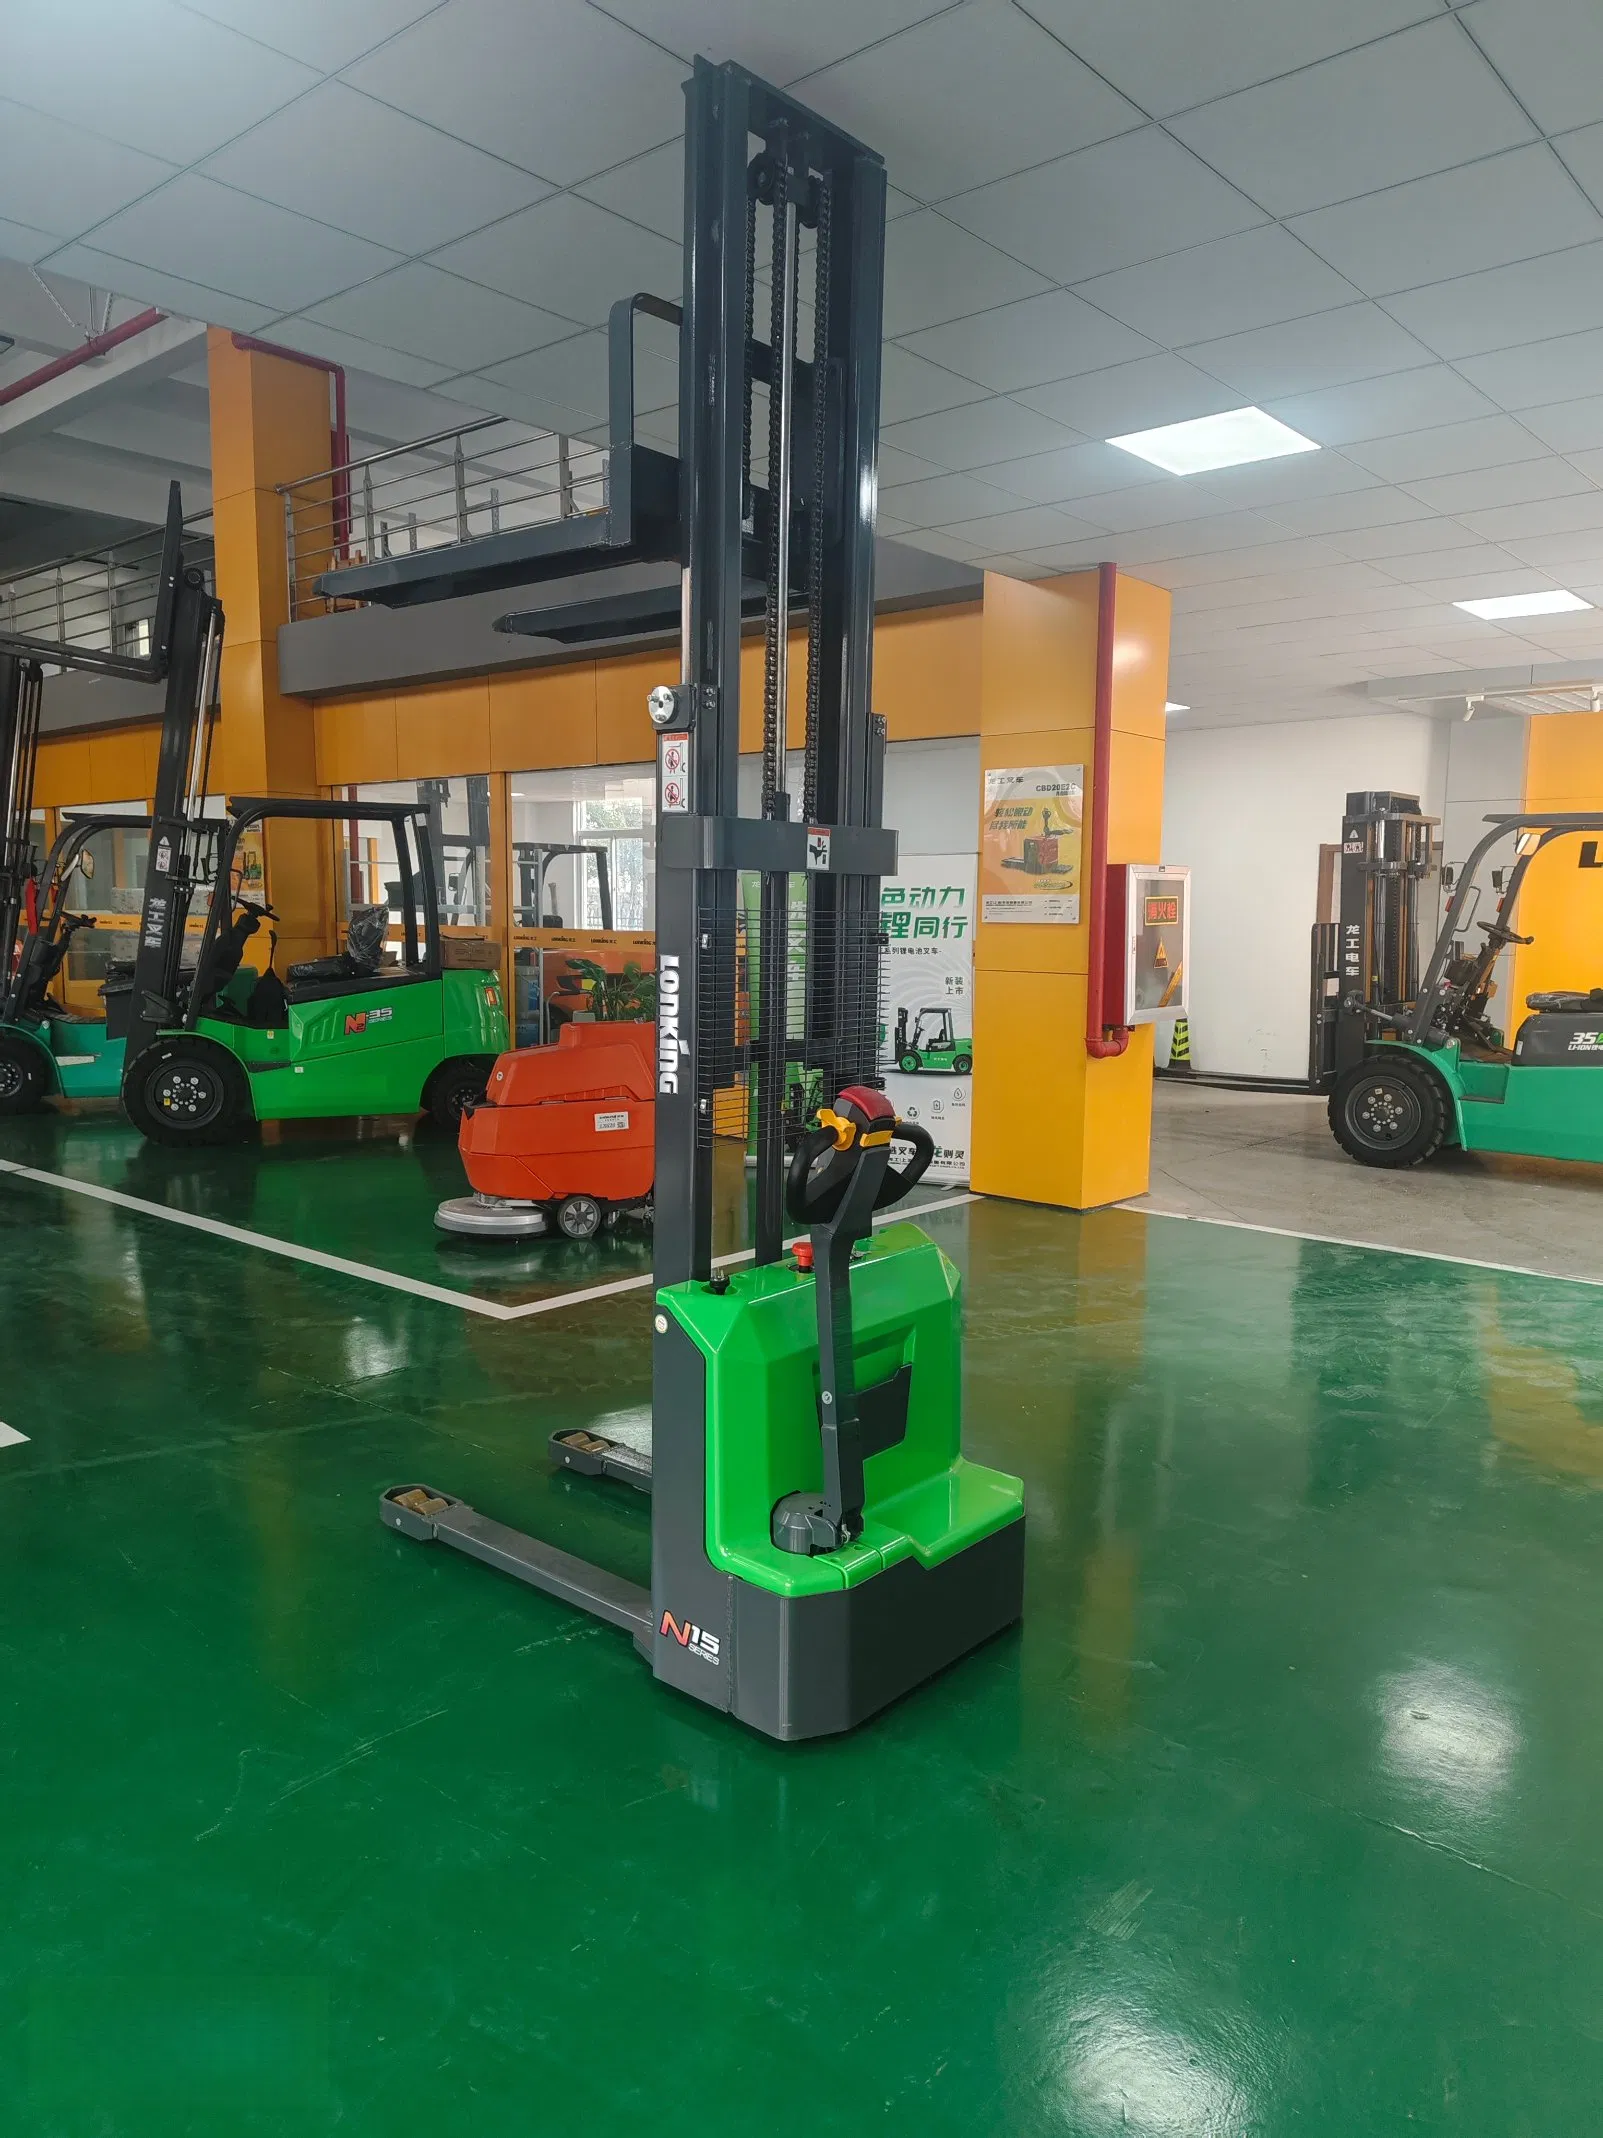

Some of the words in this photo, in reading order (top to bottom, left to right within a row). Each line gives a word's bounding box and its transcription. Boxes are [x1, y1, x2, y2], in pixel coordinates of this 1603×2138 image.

[1148, 901, 1176, 920] 消火栓
[1345, 924, 1360, 976] 龙工电车
[945, 976, 964, 986] 新装
[945, 986, 964, 996] 上市
[1569, 1031, 1600, 1045] 35
[688, 1642, 720, 1666] SERIES
